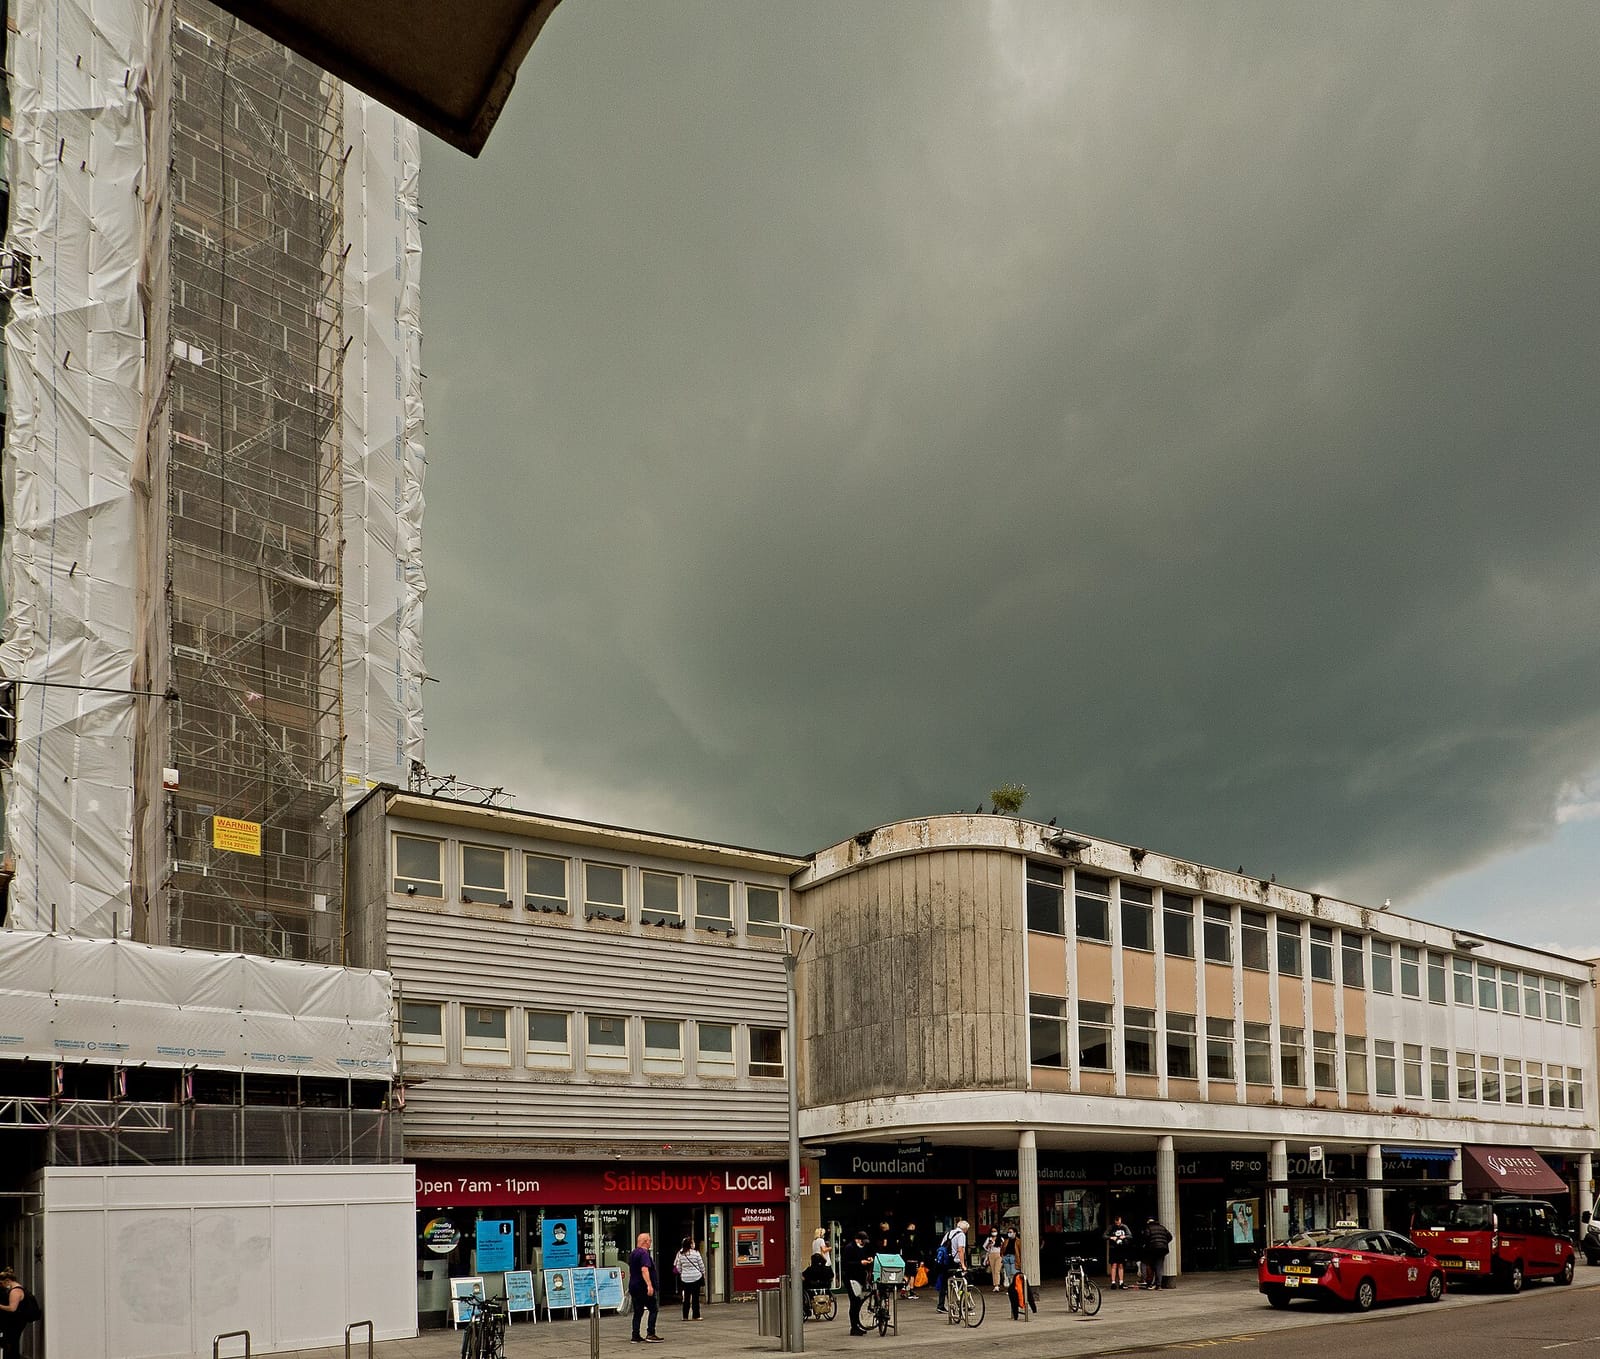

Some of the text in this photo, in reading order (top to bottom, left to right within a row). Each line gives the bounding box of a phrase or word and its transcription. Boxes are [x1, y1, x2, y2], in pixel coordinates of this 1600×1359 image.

[216, 819, 258, 831] WARNING
[852, 1156, 925, 1173] Poundland
[1287, 1158, 1335, 1175] CORAL
[1498, 1157, 1537, 1167] COFFEE
[458, 1179, 492, 1193] 7am
[505, 1179, 541, 1194] 11pm
[603, 1171, 720, 1195] Sainsbury's
[725, 1171, 773, 1190] Local
